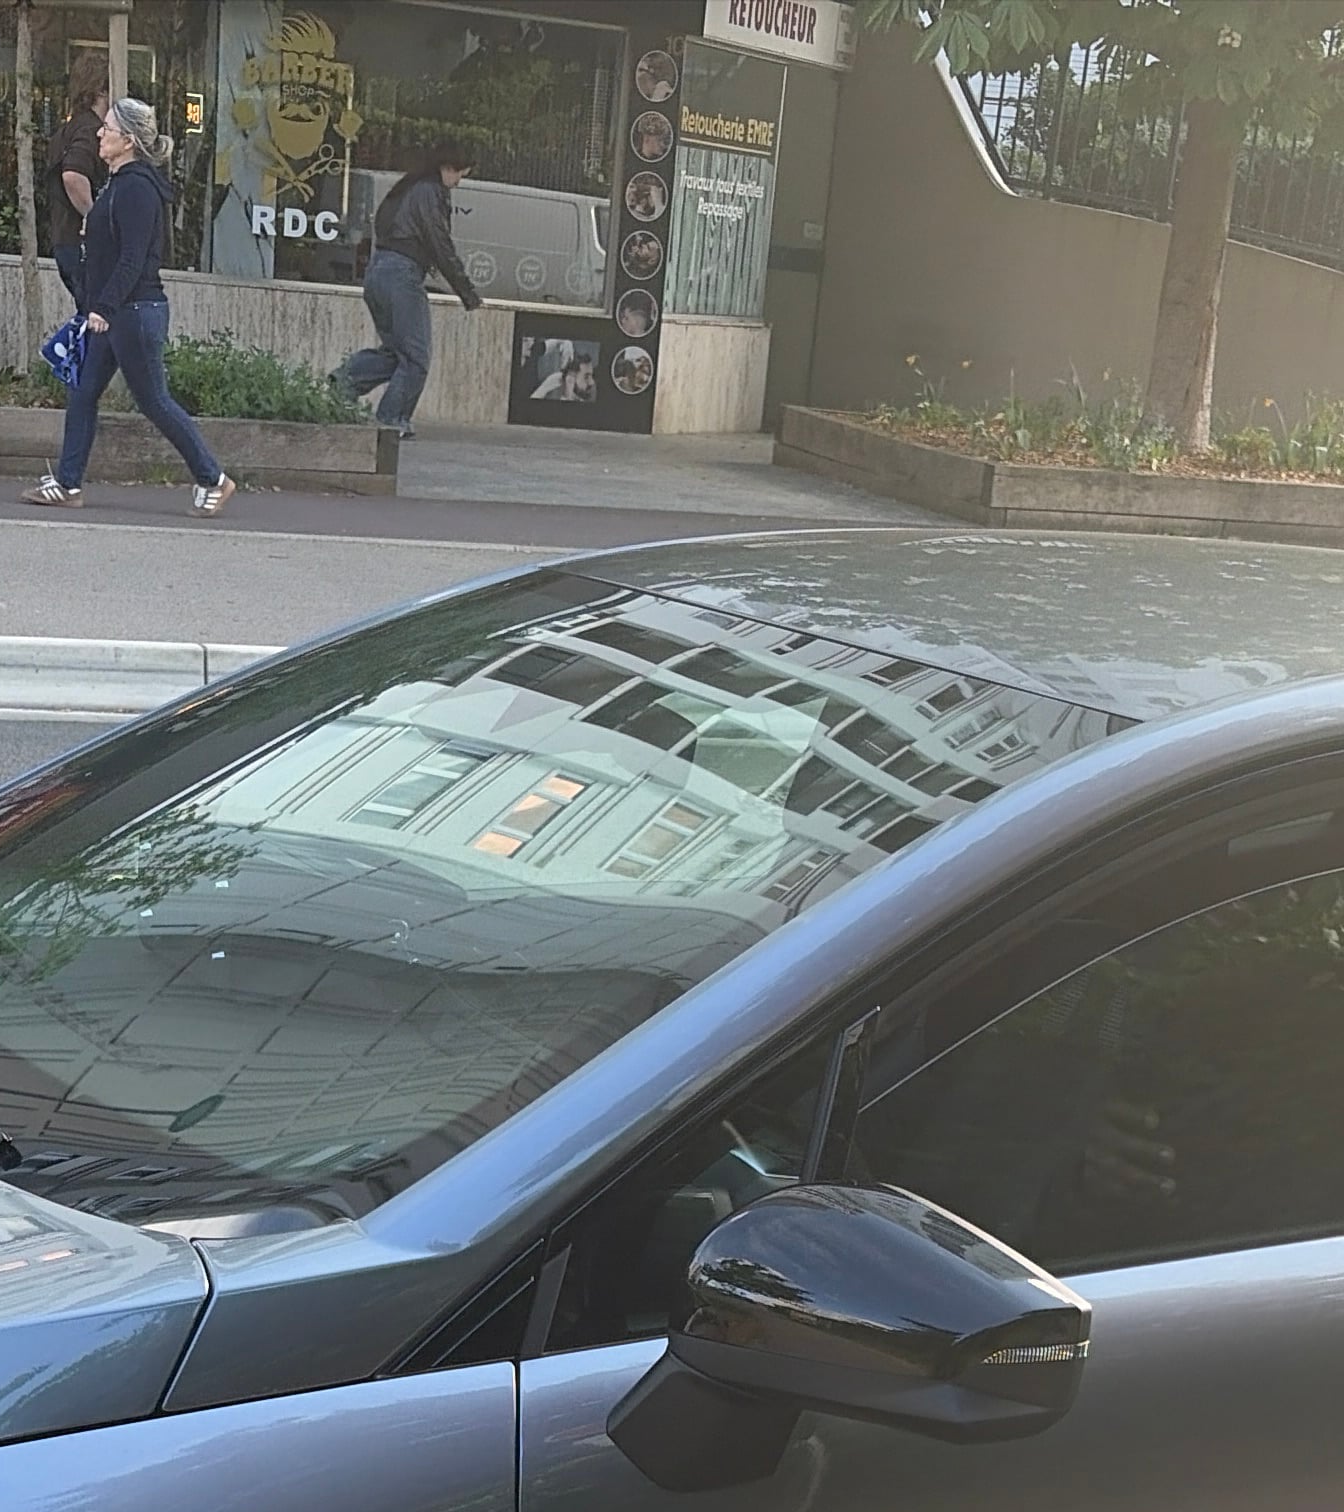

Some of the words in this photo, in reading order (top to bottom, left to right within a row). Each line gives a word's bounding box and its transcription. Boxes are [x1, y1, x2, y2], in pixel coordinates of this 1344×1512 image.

[681, 105, 746, 143] Retoucherie
[746, 117, 775, 147] EMRE
[680, 169, 715, 192] Travaux
[251, 204, 340, 241] RDC
[697, 196, 745, 222] Repassage
